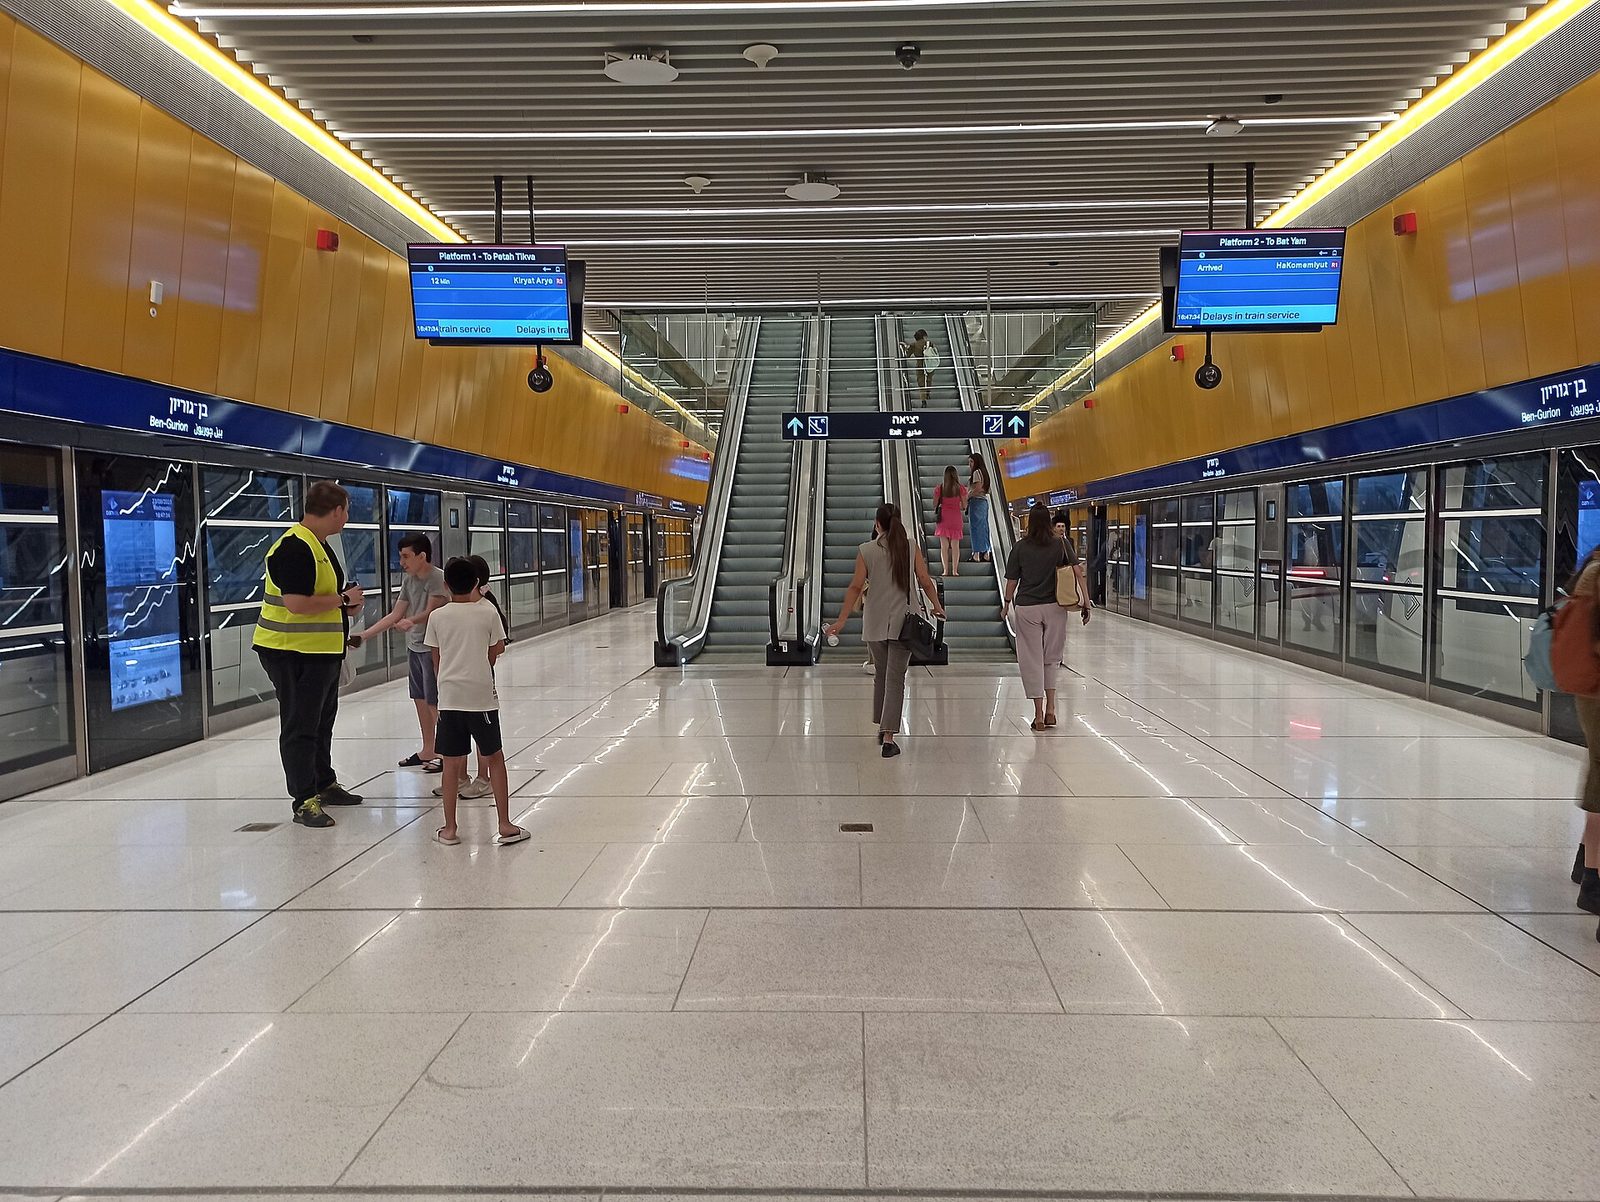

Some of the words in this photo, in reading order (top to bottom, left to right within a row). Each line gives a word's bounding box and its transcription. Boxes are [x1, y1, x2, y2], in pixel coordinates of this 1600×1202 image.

[1220, 237, 1253, 247] Platform
[1254, 238, 1259, 246] 2
[1276, 237, 1289, 245] Bat
[1290, 237, 1306, 245] Yam
[439, 252, 471, 262] Platform
[472, 253, 476, 261] 1
[483, 252, 492, 261] To
[493, 252, 514, 261] Petah
[515, 252, 536, 261] Tikva
[1197, 263, 1223, 272] Arrived
[1276, 261, 1328, 270] HaKomemiyut
[431, 277, 439, 285] 12
[513, 277, 535, 286] Kiryat
[536, 277, 553, 286] Arye
[1202, 312, 1233, 322] Delays
[1234, 312, 1244, 320] in
[1245, 311, 1265, 320] train
[1266, 311, 1300, 320] service
[459, 325, 491, 334] service
[516, 325, 546, 335] Delays
[547, 325, 556, 334] in
[1521, 407, 1561, 422] Ben-Gurion
[149, 415, 188, 432] Ben-Gurion
[892, 415, 919, 425] יציאה
[889, 428, 902, 436] Exit
